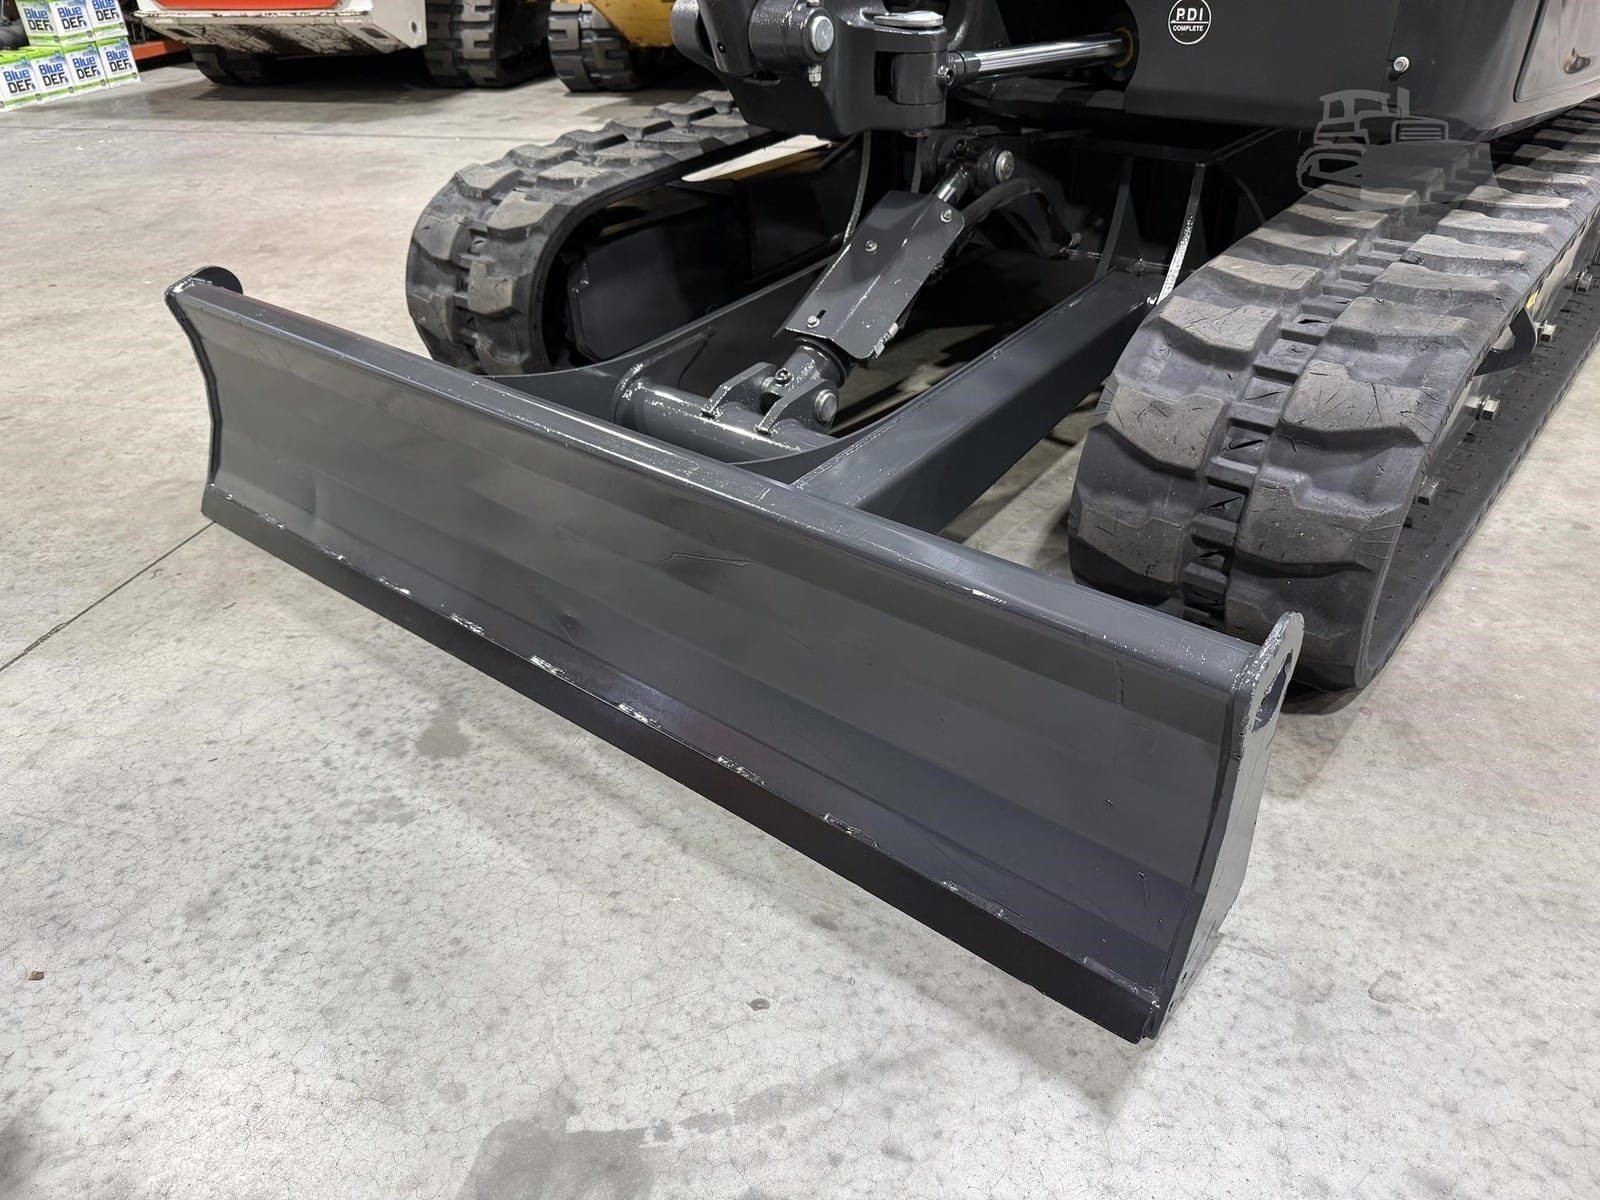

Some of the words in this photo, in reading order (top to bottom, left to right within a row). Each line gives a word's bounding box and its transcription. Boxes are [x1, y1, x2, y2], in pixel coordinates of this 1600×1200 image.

[24, 8, 48, 19] Blue
[57, 6, 82, 18] Blue
[95, 8, 117, 20] DEF
[27, 19, 50, 31] DEF
[61, 16, 84, 29] DEF
[105, 50, 128, 61] Blue
[72, 56, 97, 68] Blue
[109, 58, 130, 72] DEF
[3, 69, 31, 81] Blue
[38, 63, 64, 75] Blue
[76, 65, 98, 79] DEF
[42, 71, 66, 86] DEF
[7, 78, 32, 93] DEF
